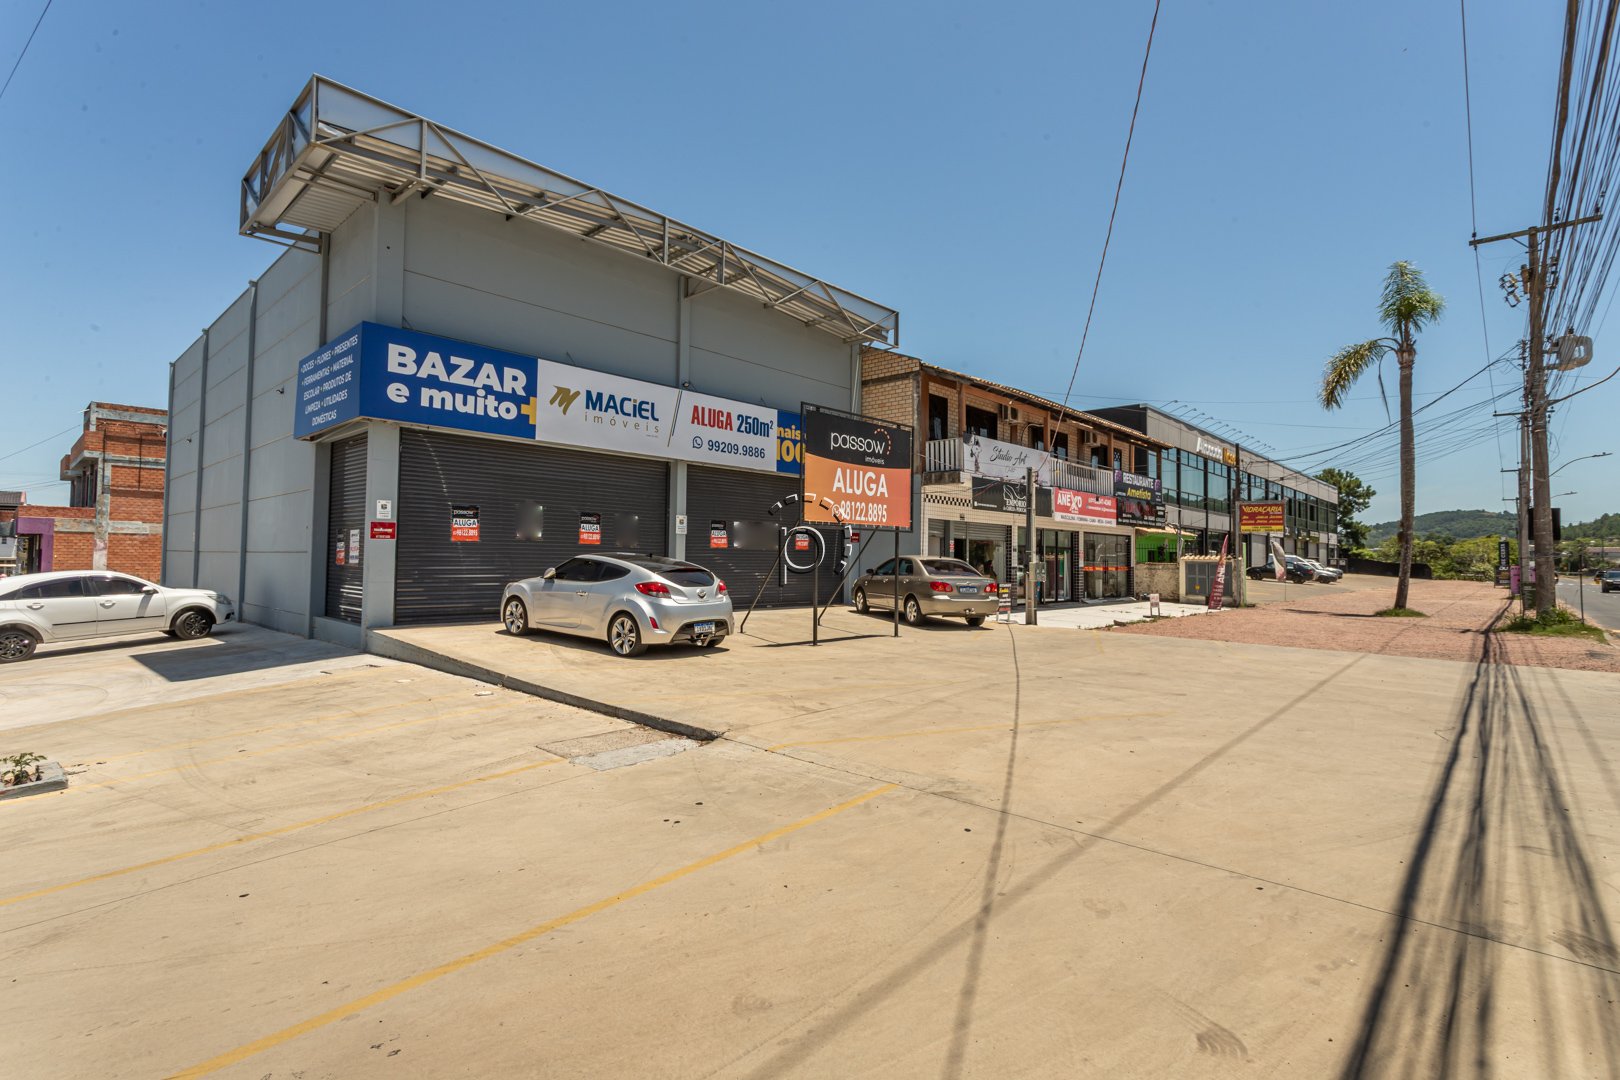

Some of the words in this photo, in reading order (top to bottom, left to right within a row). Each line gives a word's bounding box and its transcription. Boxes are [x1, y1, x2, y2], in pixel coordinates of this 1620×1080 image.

[316, 350, 331, 365] FLORES
[334, 334, 358, 355] PRESENTES
[304, 366, 330, 386] FERRAMENTAS
[333, 354, 354, 372] MATERIAL
[387, 343, 527, 396] BAZAR
[304, 386, 320, 400] ESCOLAR
[323, 374, 345, 392] PRODUTOS
[345, 370, 352, 383] DE
[386, 382, 410, 404] e
[324, 389, 347, 407] UTILIDADES
[585, 411, 660, 433] imóveis
[691, 404, 733, 431] ALUGA
[707, 439, 766, 459] 99209.9886
[830, 431, 885, 455] passow
[832, 467, 889, 498] ALUGA
[1122, 471, 1154, 489] RESTAURANTE
[840, 500, 888, 523] 98122.8895
[1057, 491, 1082, 511] ANEXO
[1241, 505, 1282, 514] VIDRAÇARIA
[454, 519, 477, 527] ALUGA
